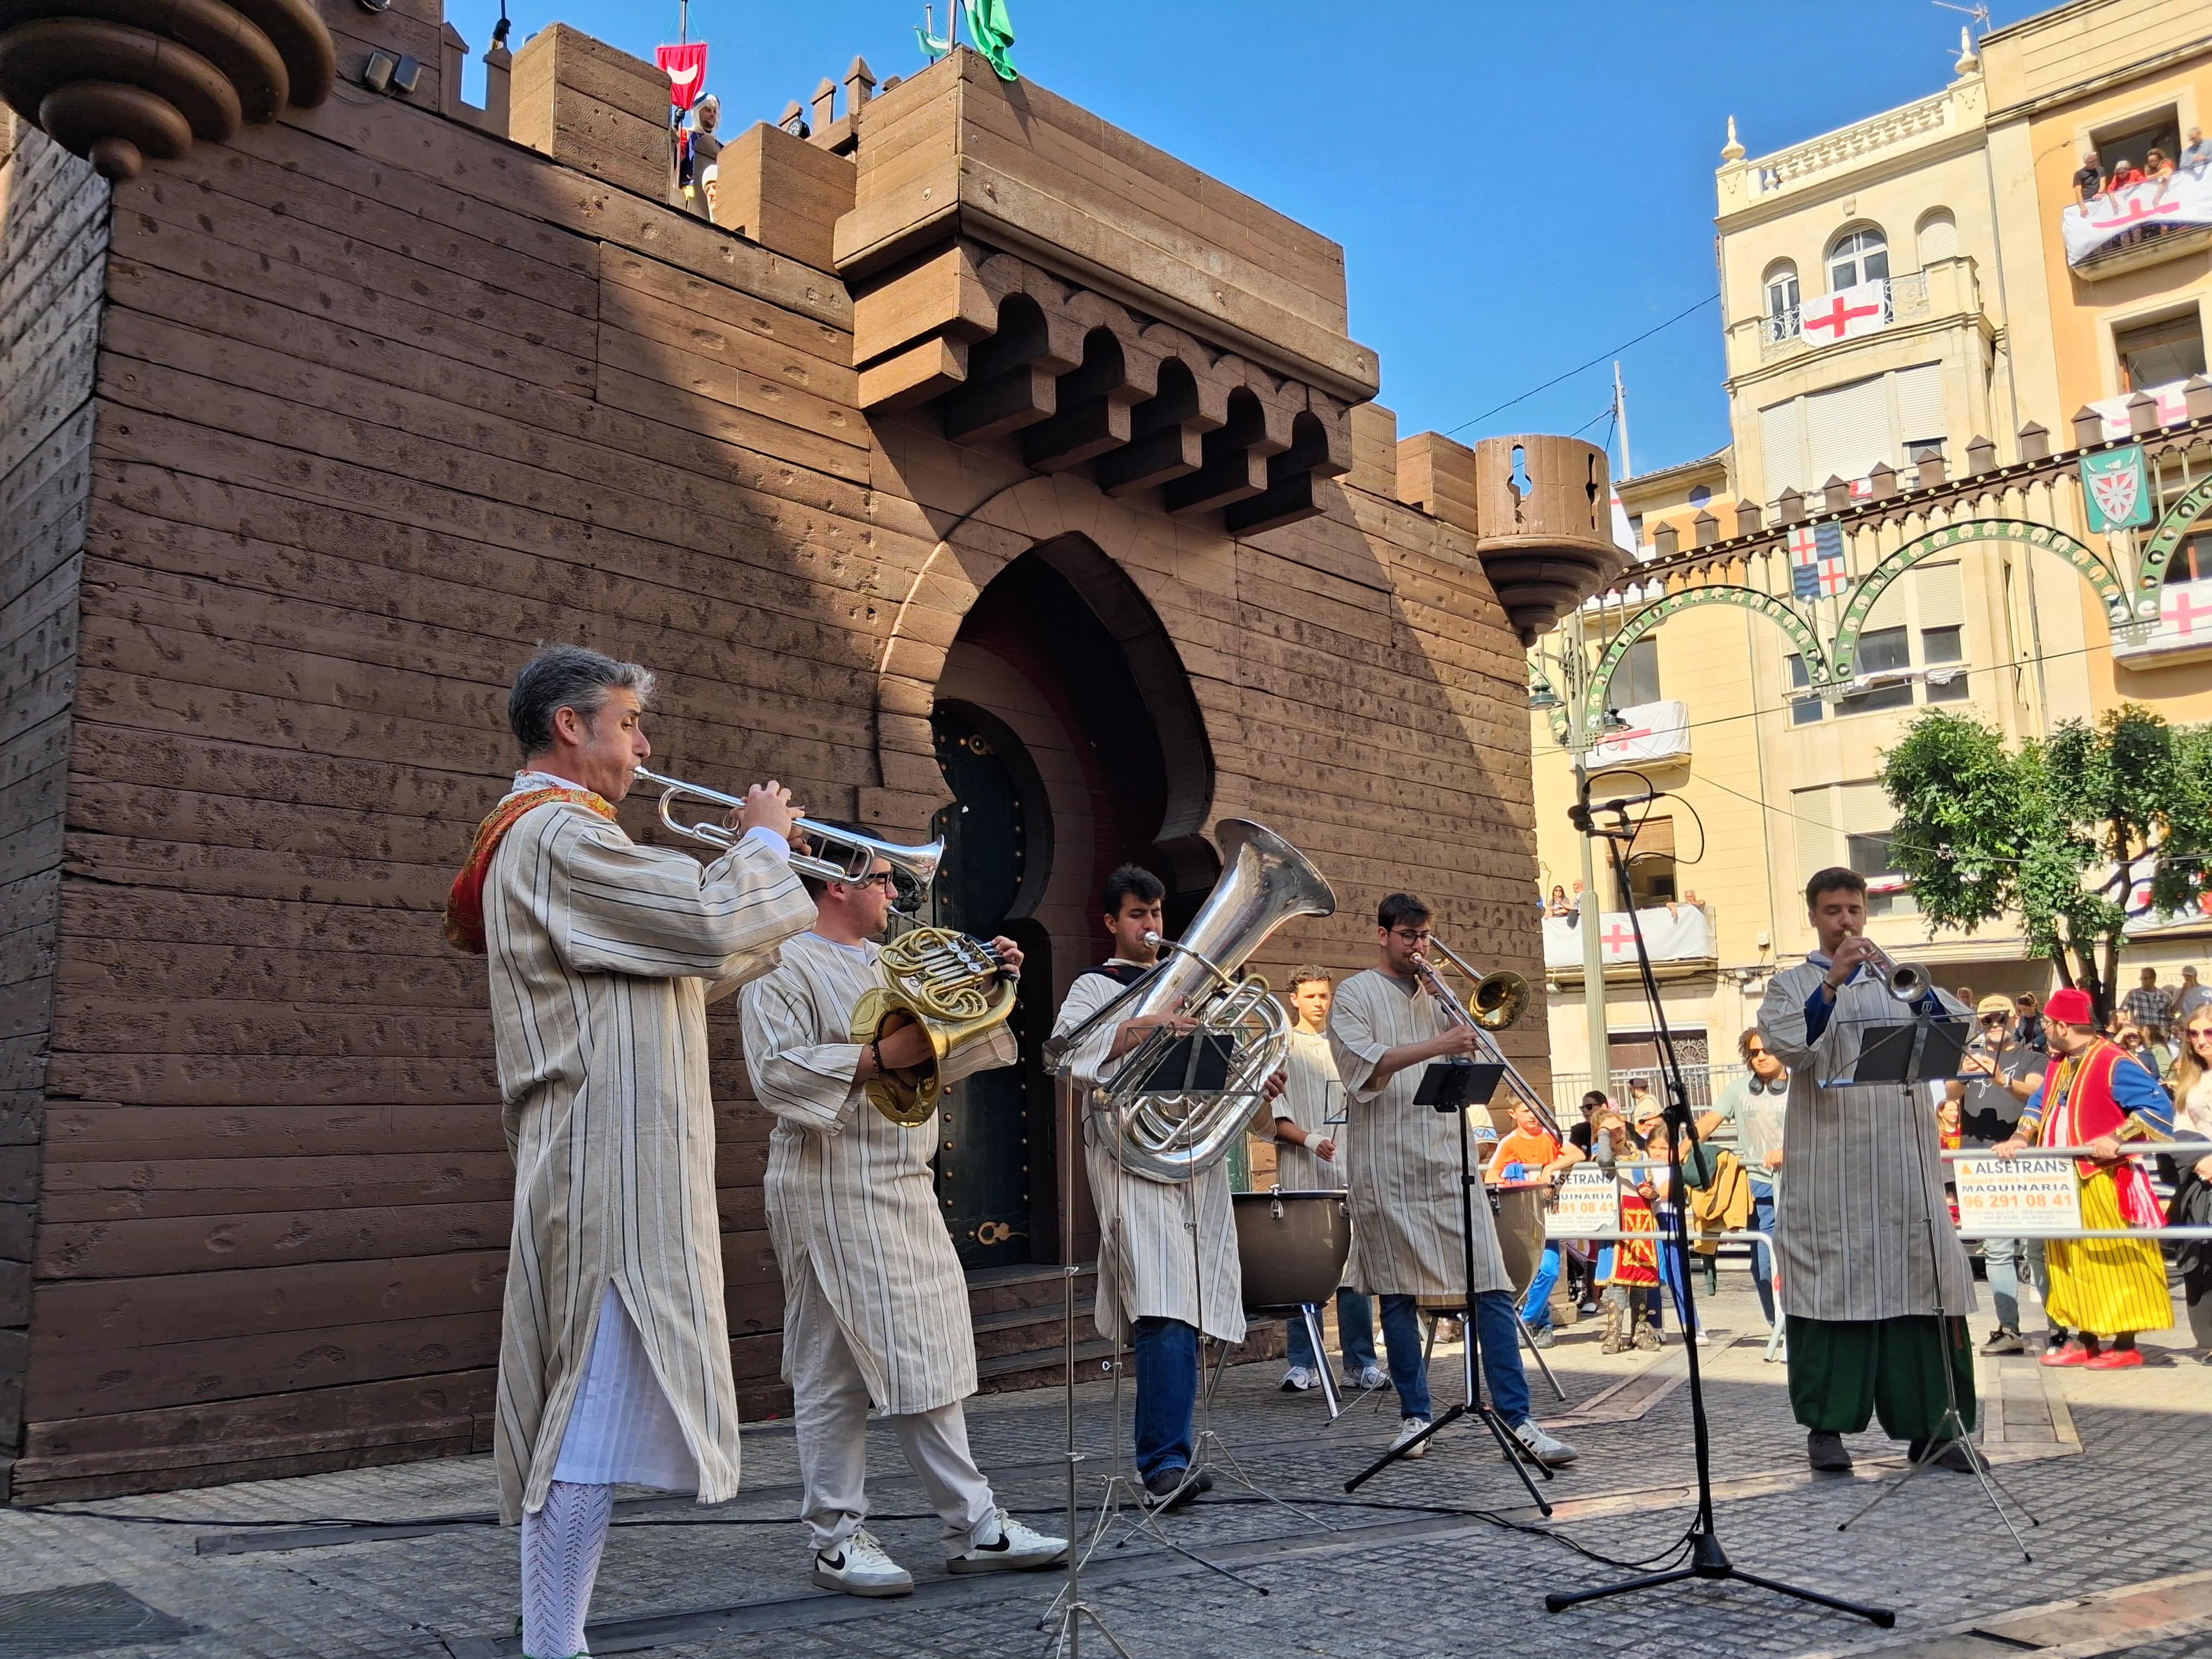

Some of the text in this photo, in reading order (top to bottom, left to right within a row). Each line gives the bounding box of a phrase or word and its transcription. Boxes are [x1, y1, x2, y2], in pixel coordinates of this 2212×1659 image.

[1975, 1160, 2068, 1174] ALSETRANS
[1962, 1184, 2070, 1192] MAQUINARIA
[1963, 1193, 2072, 1208] 96 291 08 41
[1580, 1202, 1596, 1213] 08
[1600, 1202, 1614, 1212] 41
